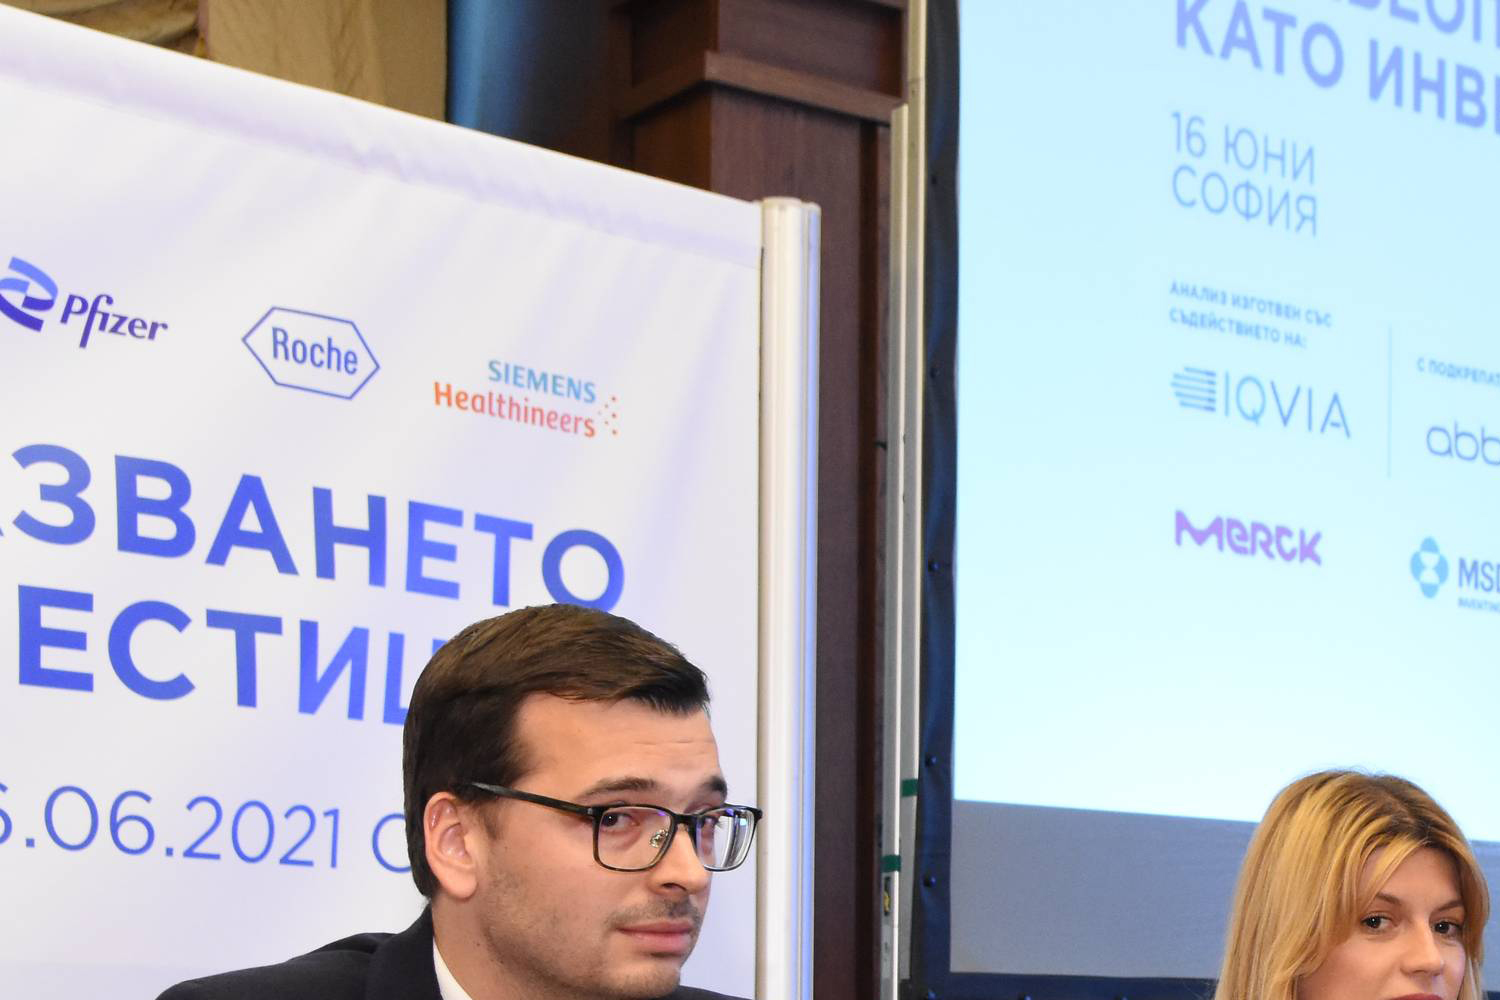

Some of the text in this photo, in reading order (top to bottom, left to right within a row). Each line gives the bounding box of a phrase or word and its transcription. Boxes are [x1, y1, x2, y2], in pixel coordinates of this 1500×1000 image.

[1176, 0, 1344, 88] КАТО
[1172, 111, 1316, 186] 16 ЮНИ
[1171, 164, 1318, 237] СОФИЯ
[60, 292, 169, 349] Pfizer
[1170, 281, 1227, 305] АНАЛИЗ
[1231, 293, 1301, 320] ИЗГОТВЕН
[271, 326, 359, 377] Roche
[488, 358, 597, 405] SIEMENS
[433, 381, 597, 439] Healthineers
[1223, 370, 1351, 439] IQVIA
[0, 443, 626, 612] ЗВАНЕТО
[0, 782, 340, 869] .06.2021
